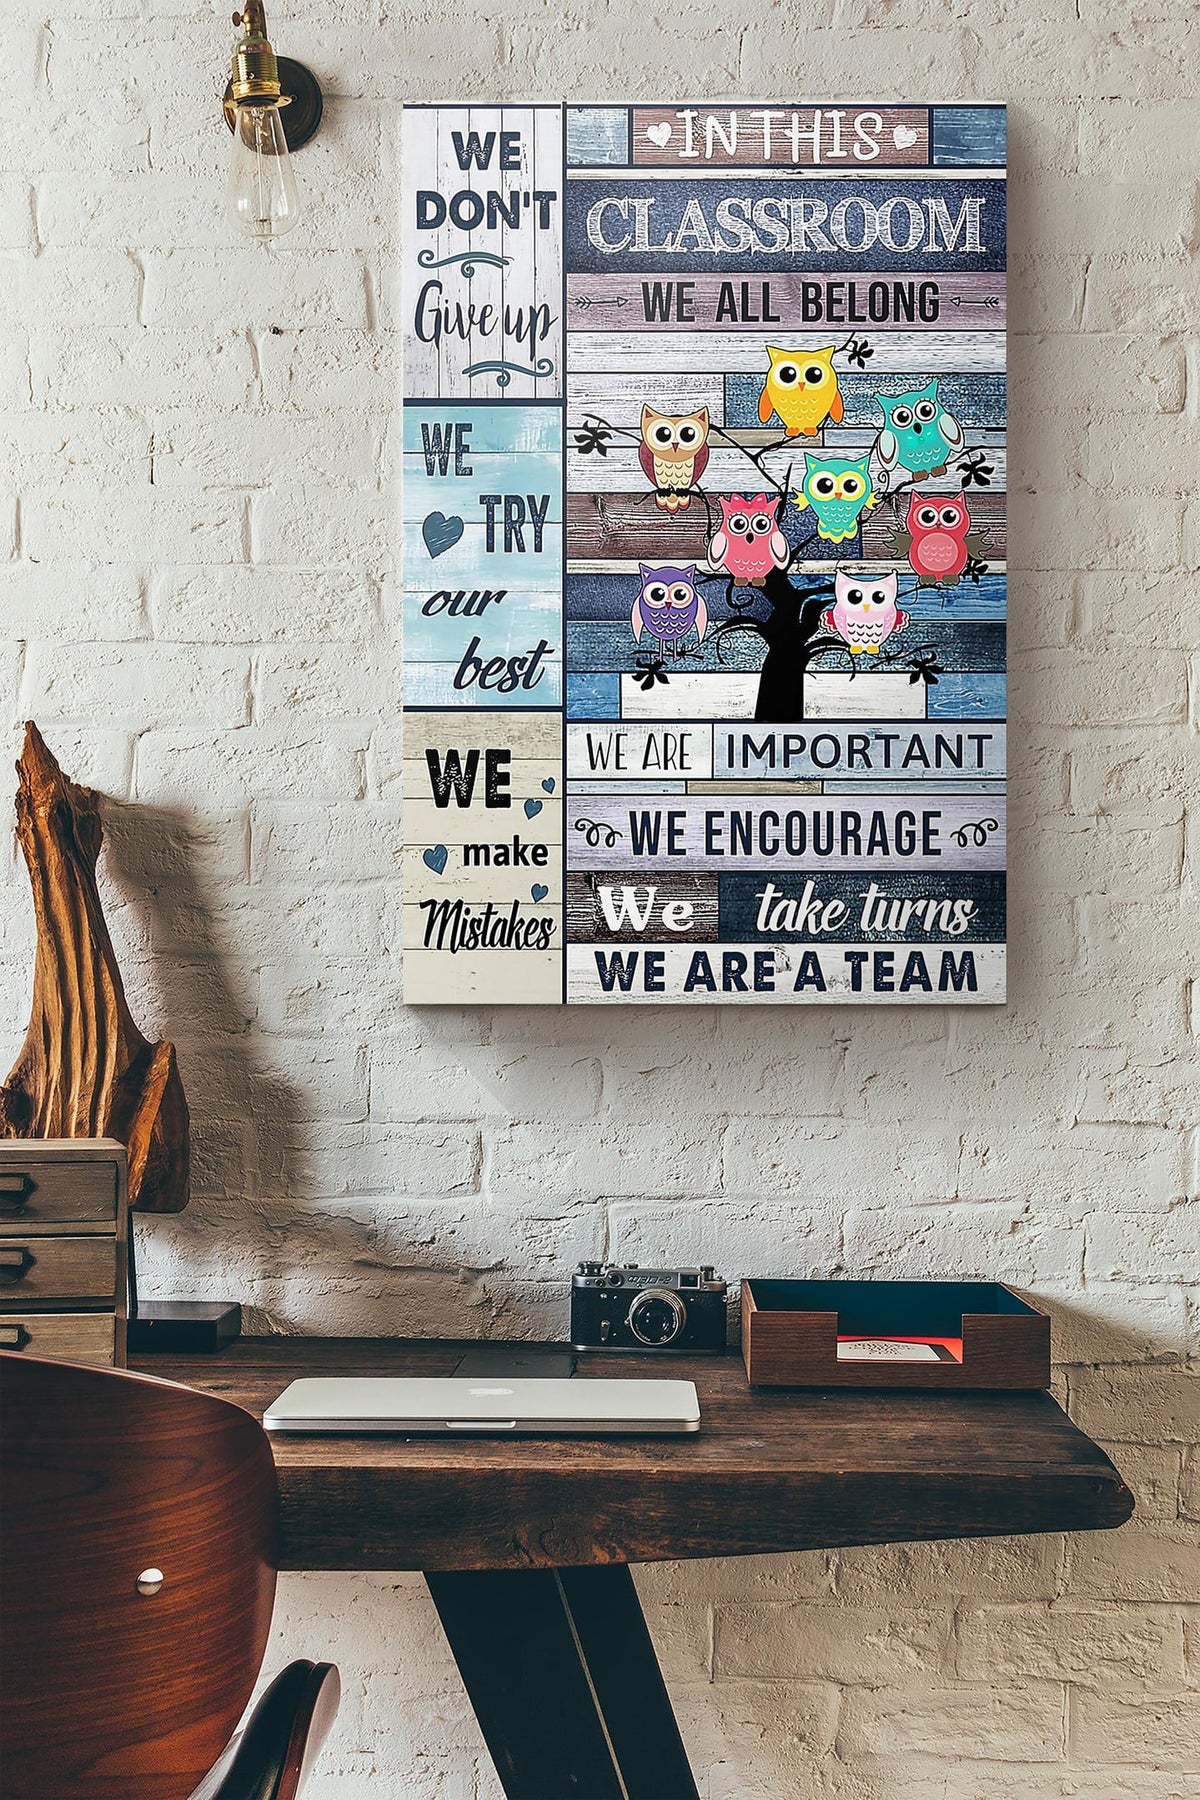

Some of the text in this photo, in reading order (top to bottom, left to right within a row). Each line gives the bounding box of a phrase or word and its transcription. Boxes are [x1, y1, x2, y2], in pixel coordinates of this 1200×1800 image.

[451, 131, 521, 170] WE
[676, 109, 883, 164] IN THIS
[416, 190, 557, 230] DON'T
[586, 196, 987, 254] CLASSROOM
[414, 280, 559, 361] Give up
[641, 281, 940, 323] WE ALL BELONG
[421, 423, 473, 476] WE
[479, 495, 550, 552] TRY
[421, 590, 508, 617] our
[453, 636, 555, 693] best
[586, 732, 993, 771] WE ARE IMPORTANT
[425, 749, 511, 808] WE
[463, 835, 548, 866] make
[629, 810, 942, 856] WE ENCOURAGE
[419, 898, 557, 954] Mistakes
[597, 880, 979, 935] We take turns
[594, 950, 979, 992] WE ARE A TEAM
